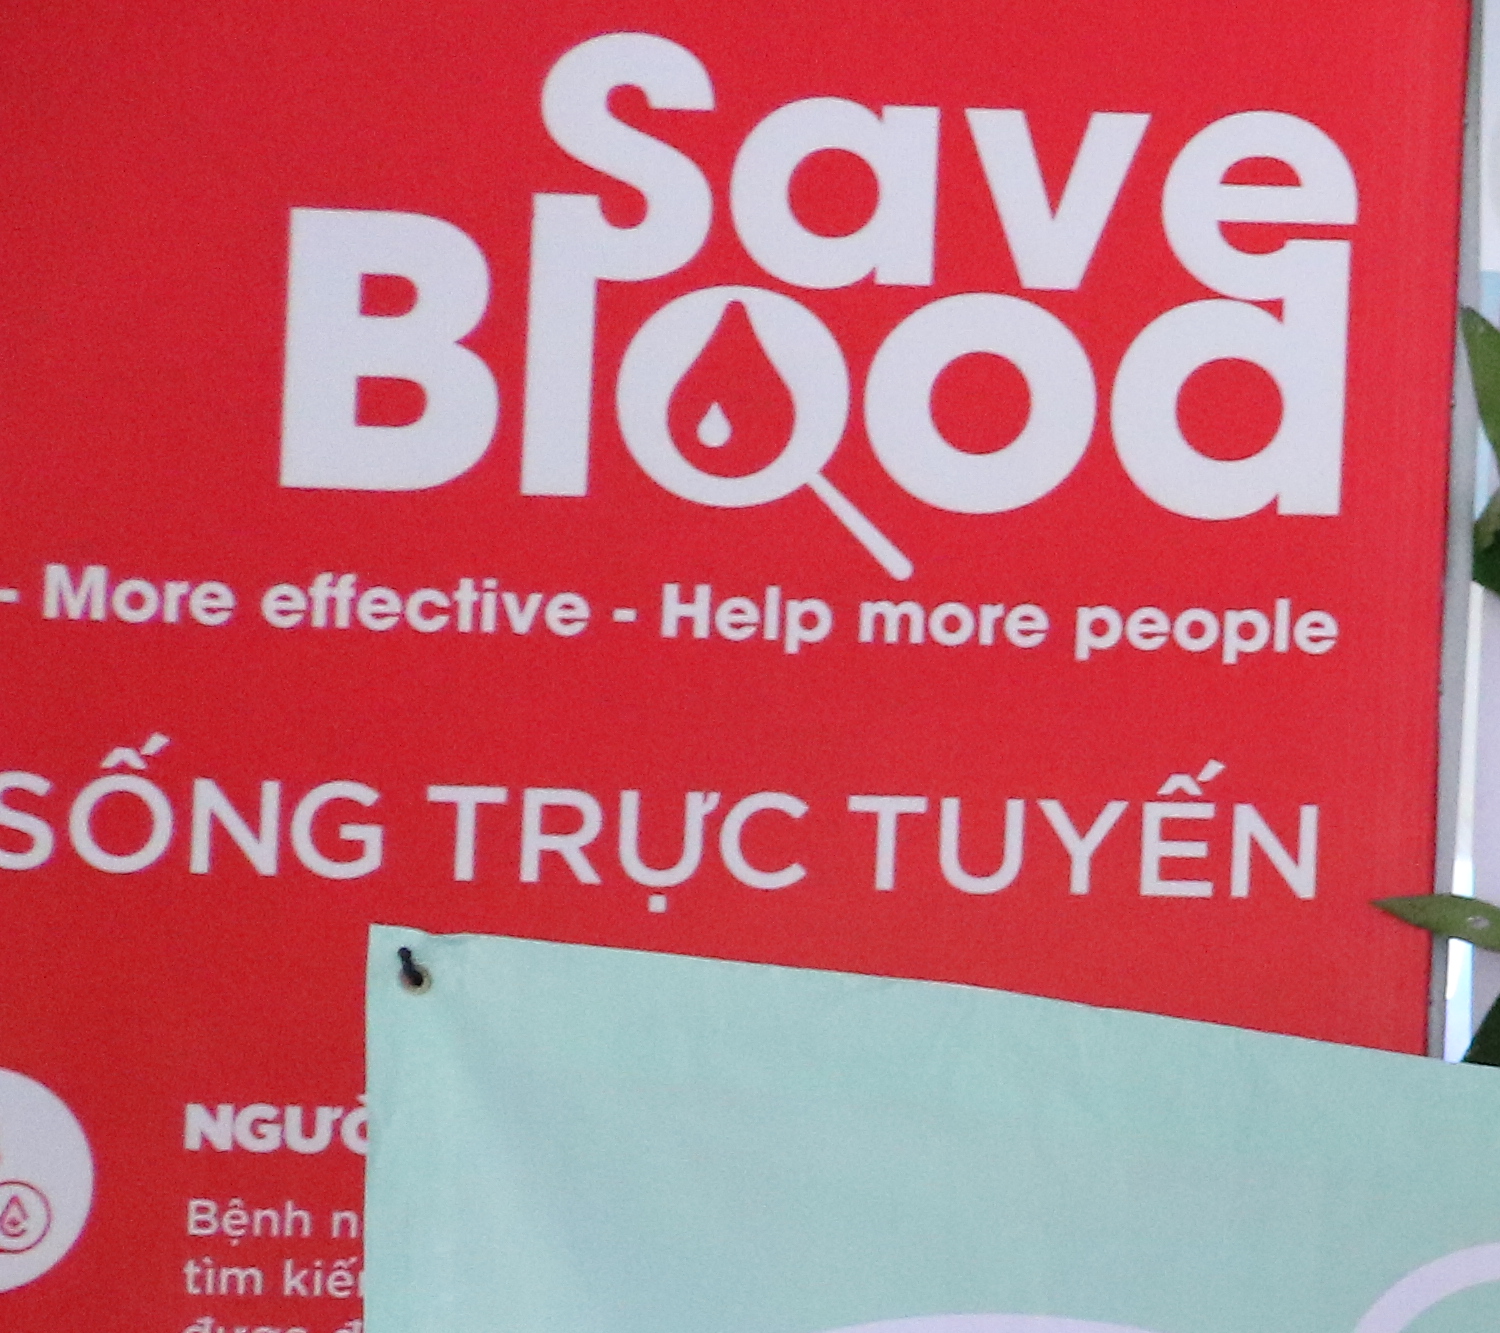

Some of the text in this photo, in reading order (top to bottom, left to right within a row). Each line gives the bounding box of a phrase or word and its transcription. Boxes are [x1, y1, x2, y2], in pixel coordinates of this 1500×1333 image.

[540, 31, 1360, 300] Save
[279, 193, 1353, 524] Blood
[43, 563, 236, 626] More
[261, 573, 592, 637] effective
[662, 586, 834, 653] Help
[859, 598, 1049, 648] more
[1075, 598, 1338, 666] people
[0, 731, 1318, 912] SỐNG TRỰC TUYẾN
[183, 1256, 364, 1297] tìm kiế
[187, 1198, 312, 1246] Bệnh
